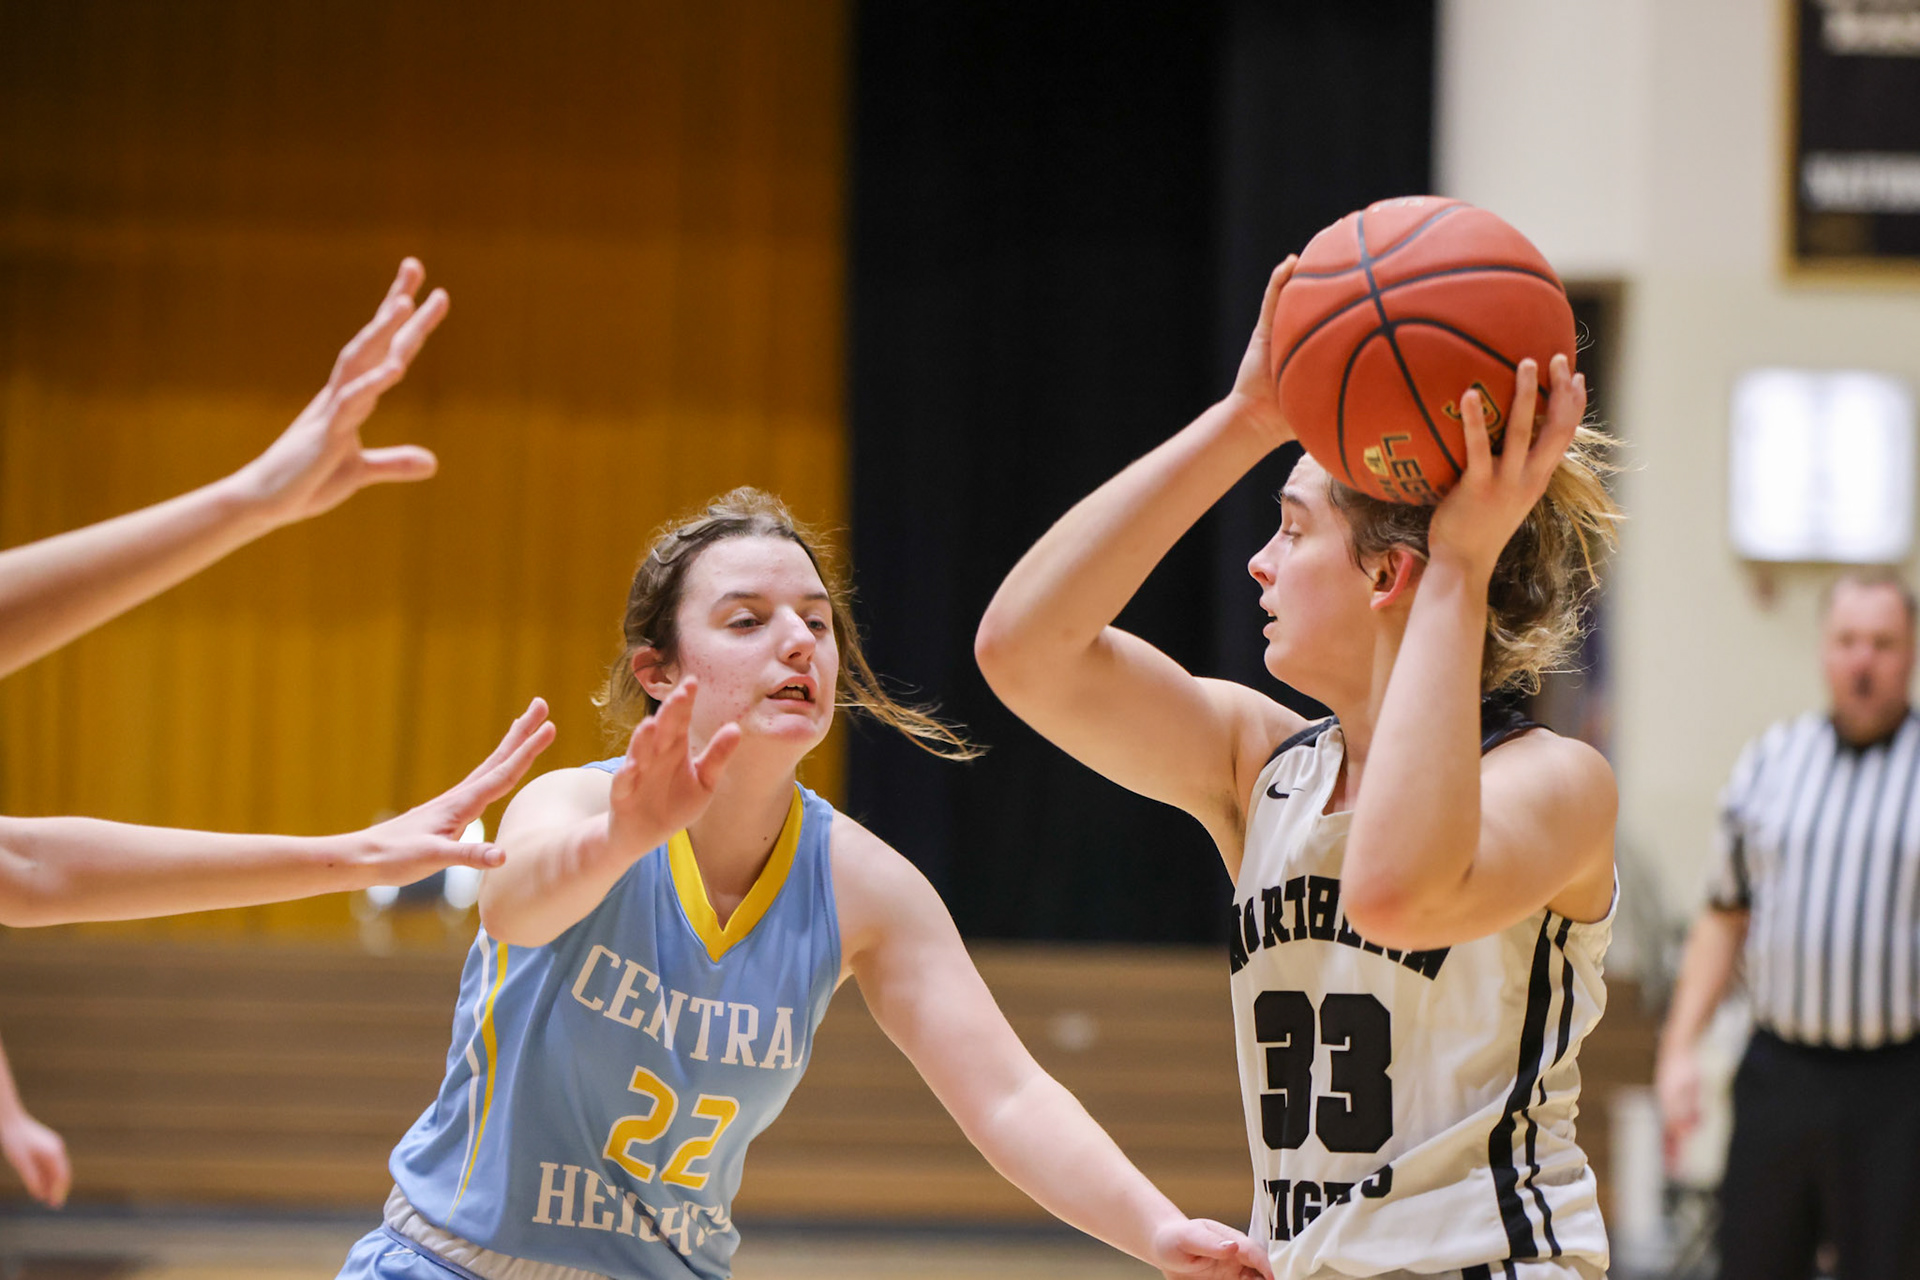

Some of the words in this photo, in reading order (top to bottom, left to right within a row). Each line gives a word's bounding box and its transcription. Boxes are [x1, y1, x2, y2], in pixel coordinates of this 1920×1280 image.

[1381, 432, 1441, 505] LEG
[603, 1065, 740, 1191] 22
[1254, 990, 1393, 1154] 33
